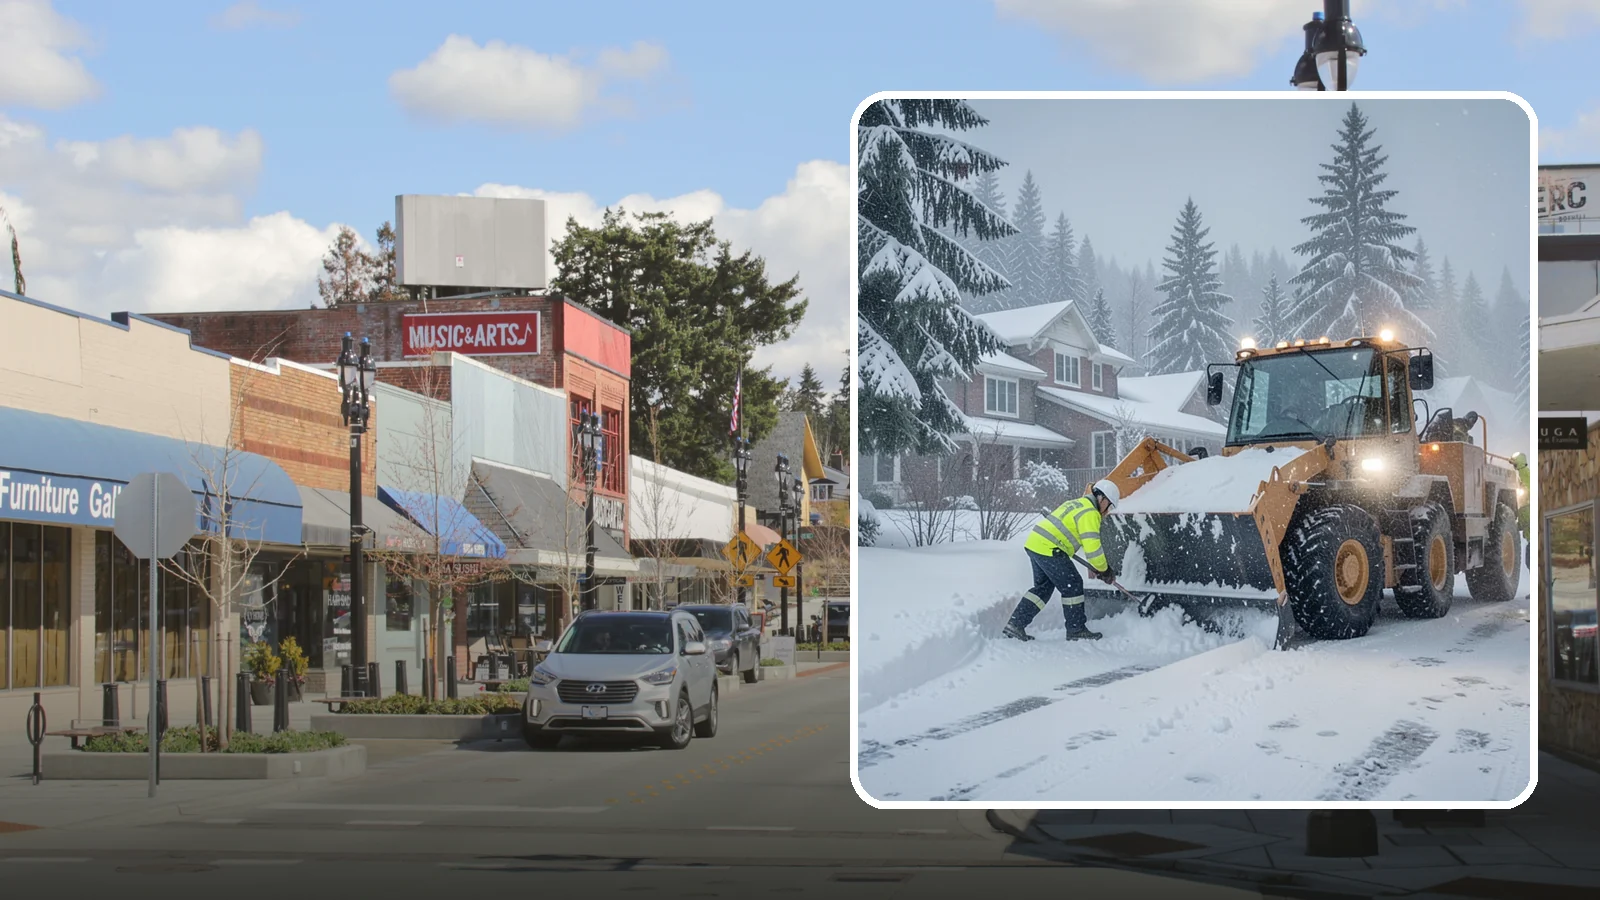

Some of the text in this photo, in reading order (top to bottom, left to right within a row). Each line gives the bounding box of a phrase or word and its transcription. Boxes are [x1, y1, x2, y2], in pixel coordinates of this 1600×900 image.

[409, 323, 519, 349] MUSIC&ARTS
[0, 471, 122, 519] Furniture Gal
[453, 563, 479, 574] SUSHI
